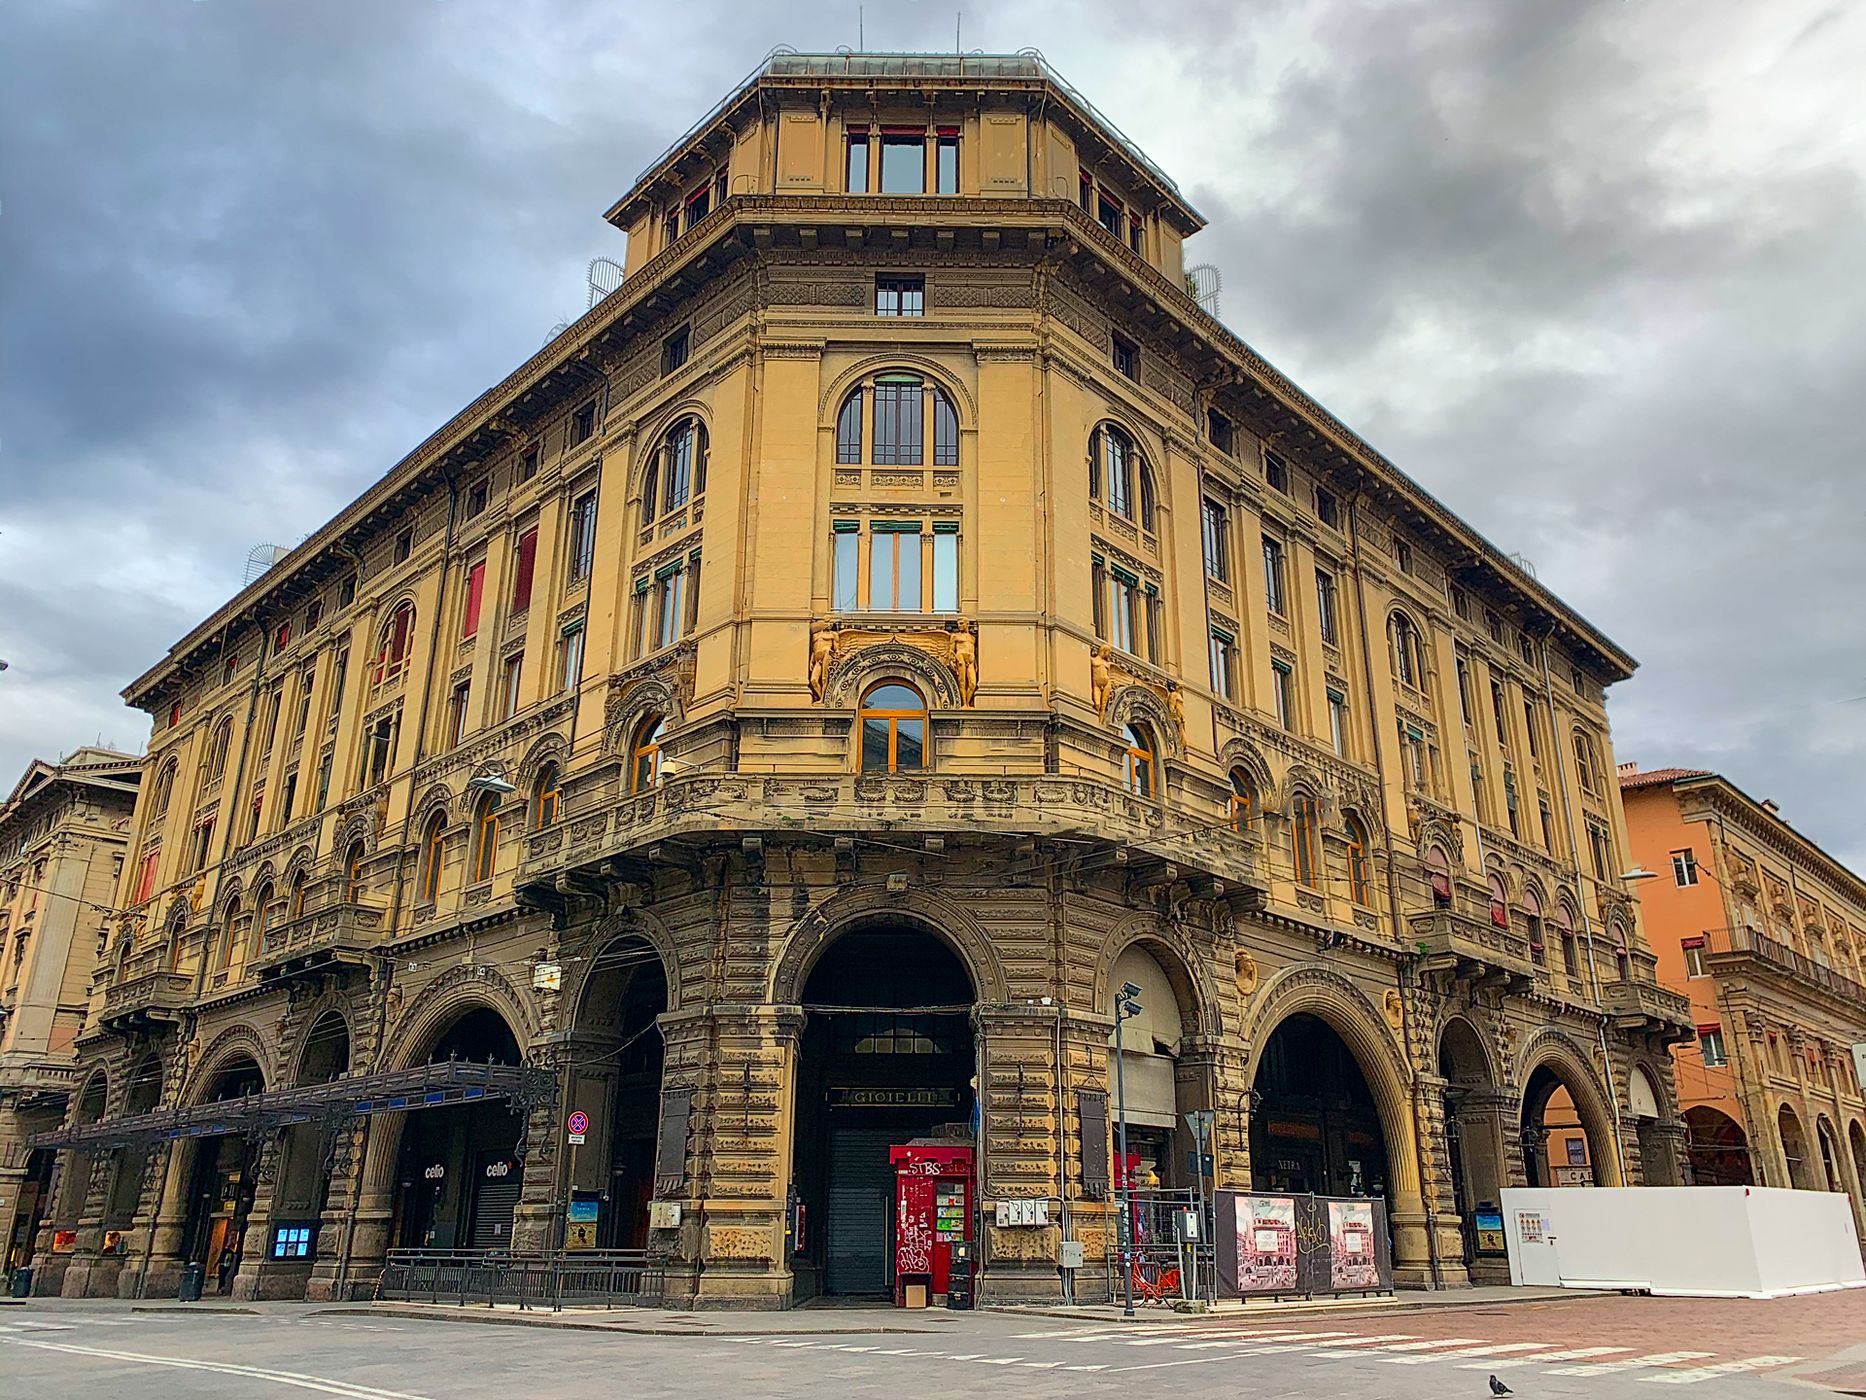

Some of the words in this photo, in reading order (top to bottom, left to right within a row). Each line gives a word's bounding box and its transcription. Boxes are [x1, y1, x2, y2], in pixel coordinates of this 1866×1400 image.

[855, 1091, 932, 1102] GIOIELLI
[425, 1163, 444, 1179] celio
[486, 1161, 508, 1177] celio
